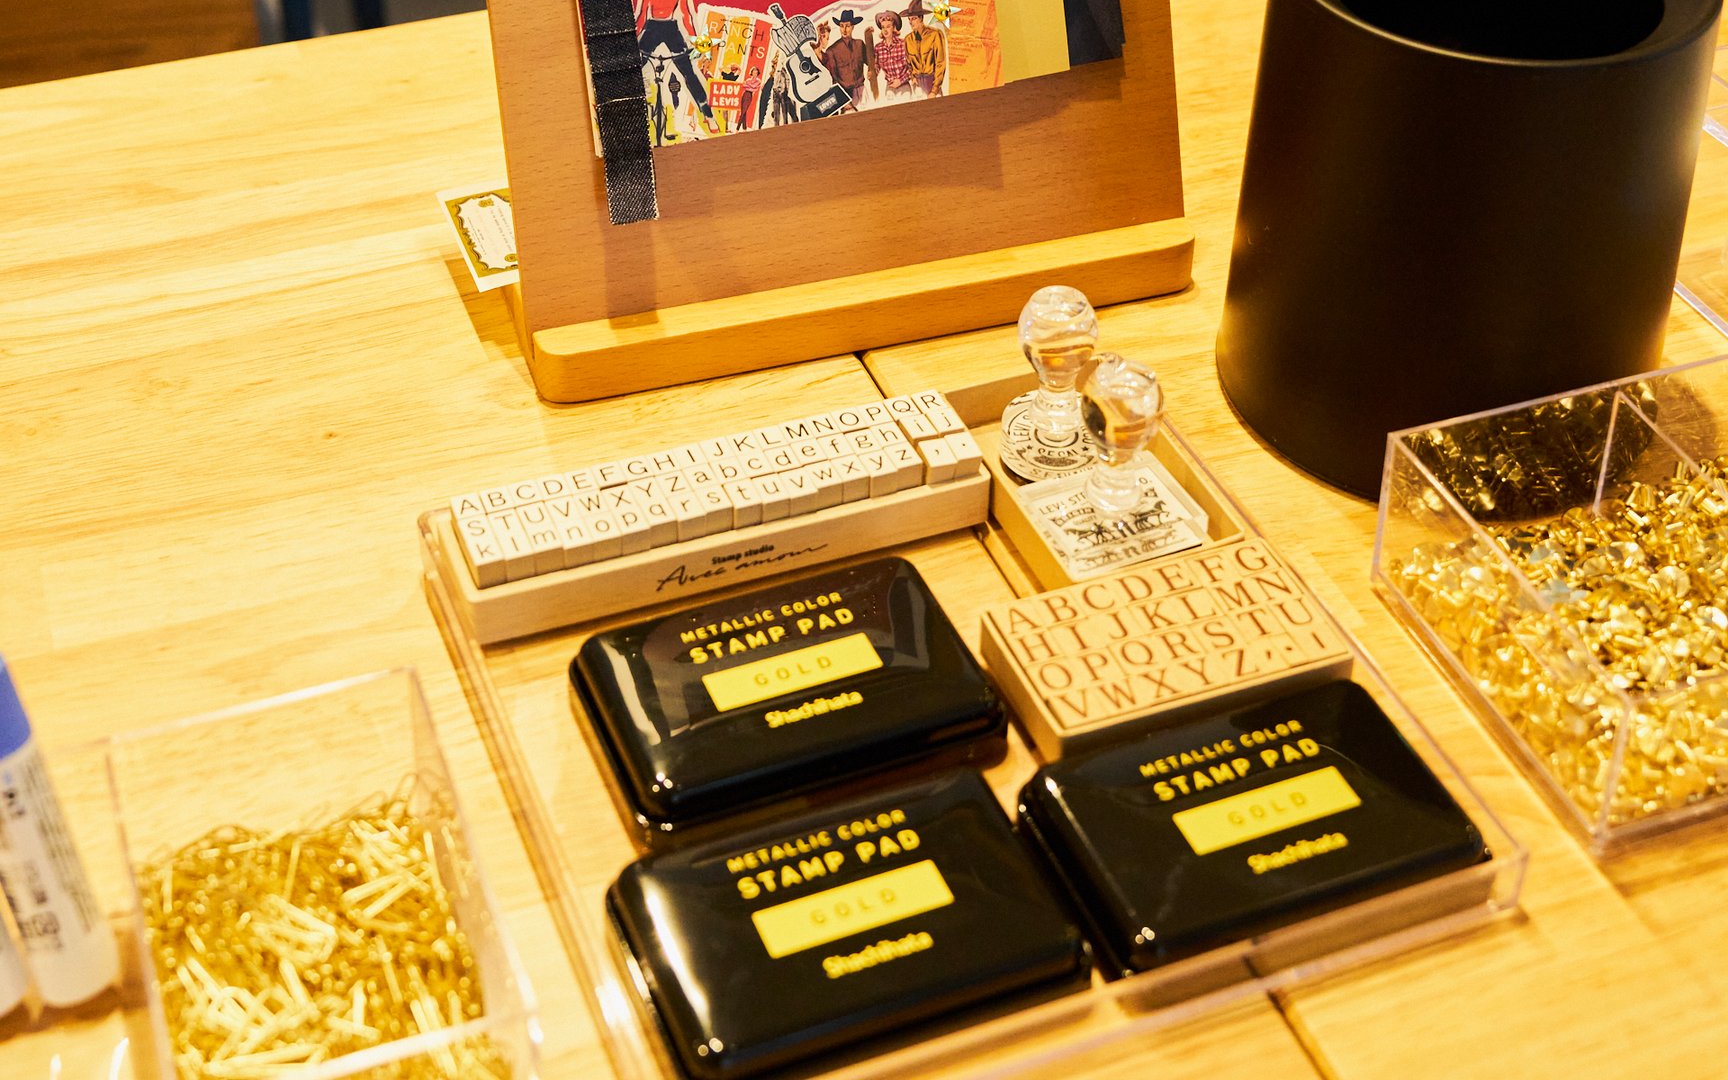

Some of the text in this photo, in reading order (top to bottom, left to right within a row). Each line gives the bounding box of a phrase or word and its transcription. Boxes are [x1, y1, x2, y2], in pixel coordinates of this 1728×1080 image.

[708, 19, 765, 42] RANCH
[712, 83, 741, 96] LADY
[711, 542, 775, 566] Stamp studio
[680, 591, 843, 644] METALLIC COLOR
[689, 607, 855, 664] STAMP PAD
[753, 655, 832, 686] GOLD
[1138, 719, 1304, 778] METALLIC COLOR
[1153, 738, 1320, 802] STAMP PAD
[1226, 791, 1308, 827] GOLD
[726, 809, 907, 874] METALLIC COLOR
[736, 828, 921, 900] STAMP PAD
[809, 887, 897, 925] GOLD
